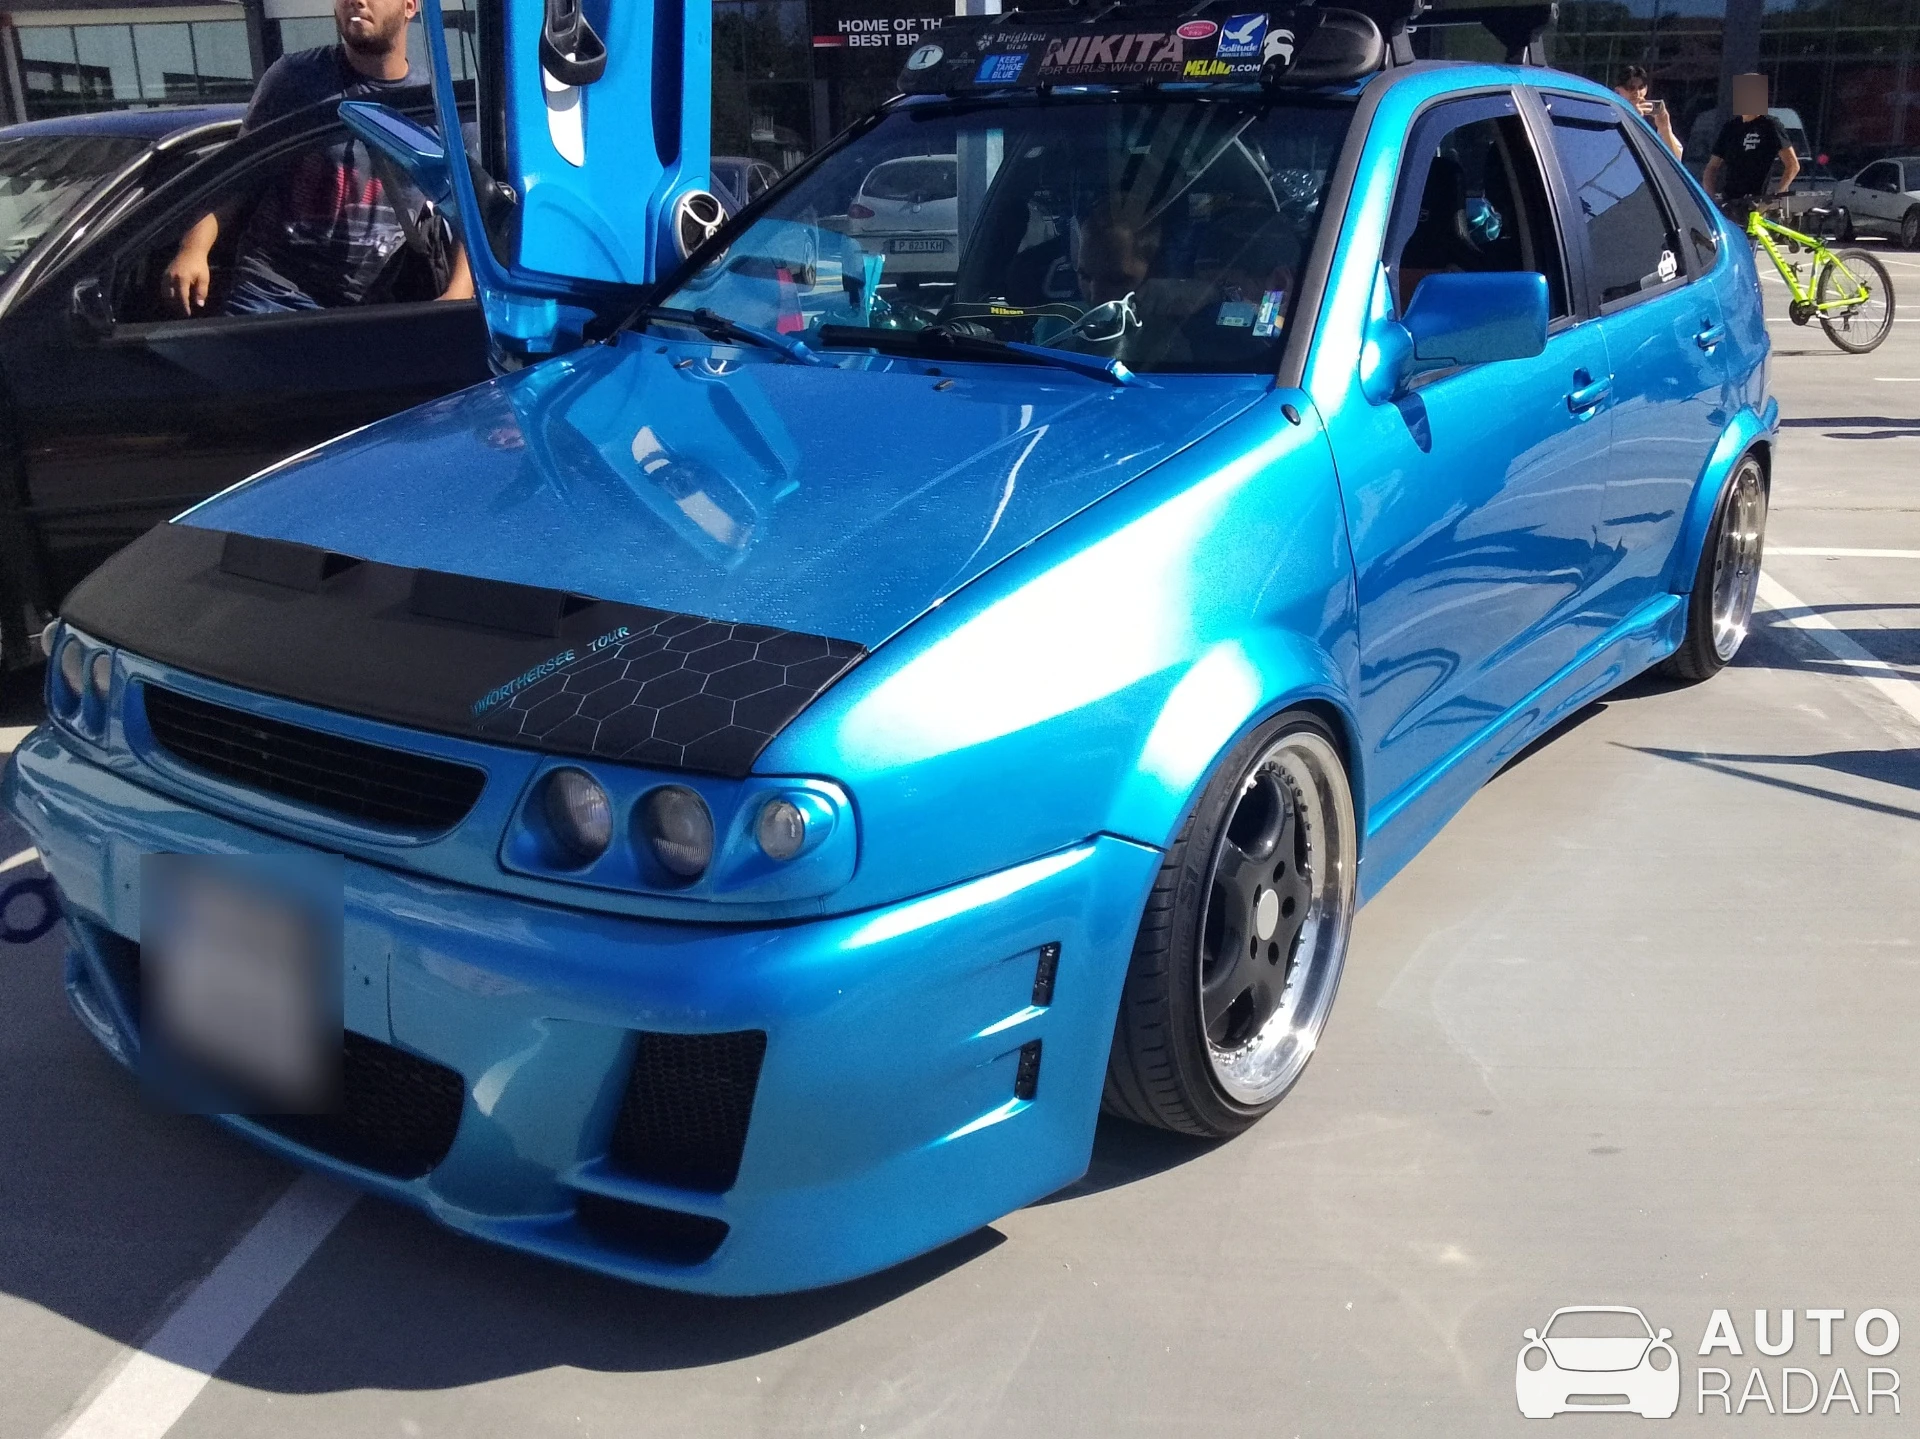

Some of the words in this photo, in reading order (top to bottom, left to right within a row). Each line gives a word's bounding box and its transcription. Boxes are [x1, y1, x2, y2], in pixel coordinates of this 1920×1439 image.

[838, 19, 889, 32] HOME
[893, 18, 916, 31] OF
[848, 34, 891, 47] BEST
[997, 31, 1046, 44] Brighton
[1041, 33, 1184, 66] NIKITA
[1219, 43, 1258, 53] Solitude
[996, 62, 1024, 71] TAHOE
[1038, 65, 1062, 75] FOR
[1066, 64, 1106, 74] GIRLS
[1110, 63, 1144, 72] WHO
[1148, 62, 1182, 72] RIDE
[992, 70, 1015, 79] BLUE
[991, 306, 1024, 315] Nikon
[587, 626, 630, 652] TOUR
